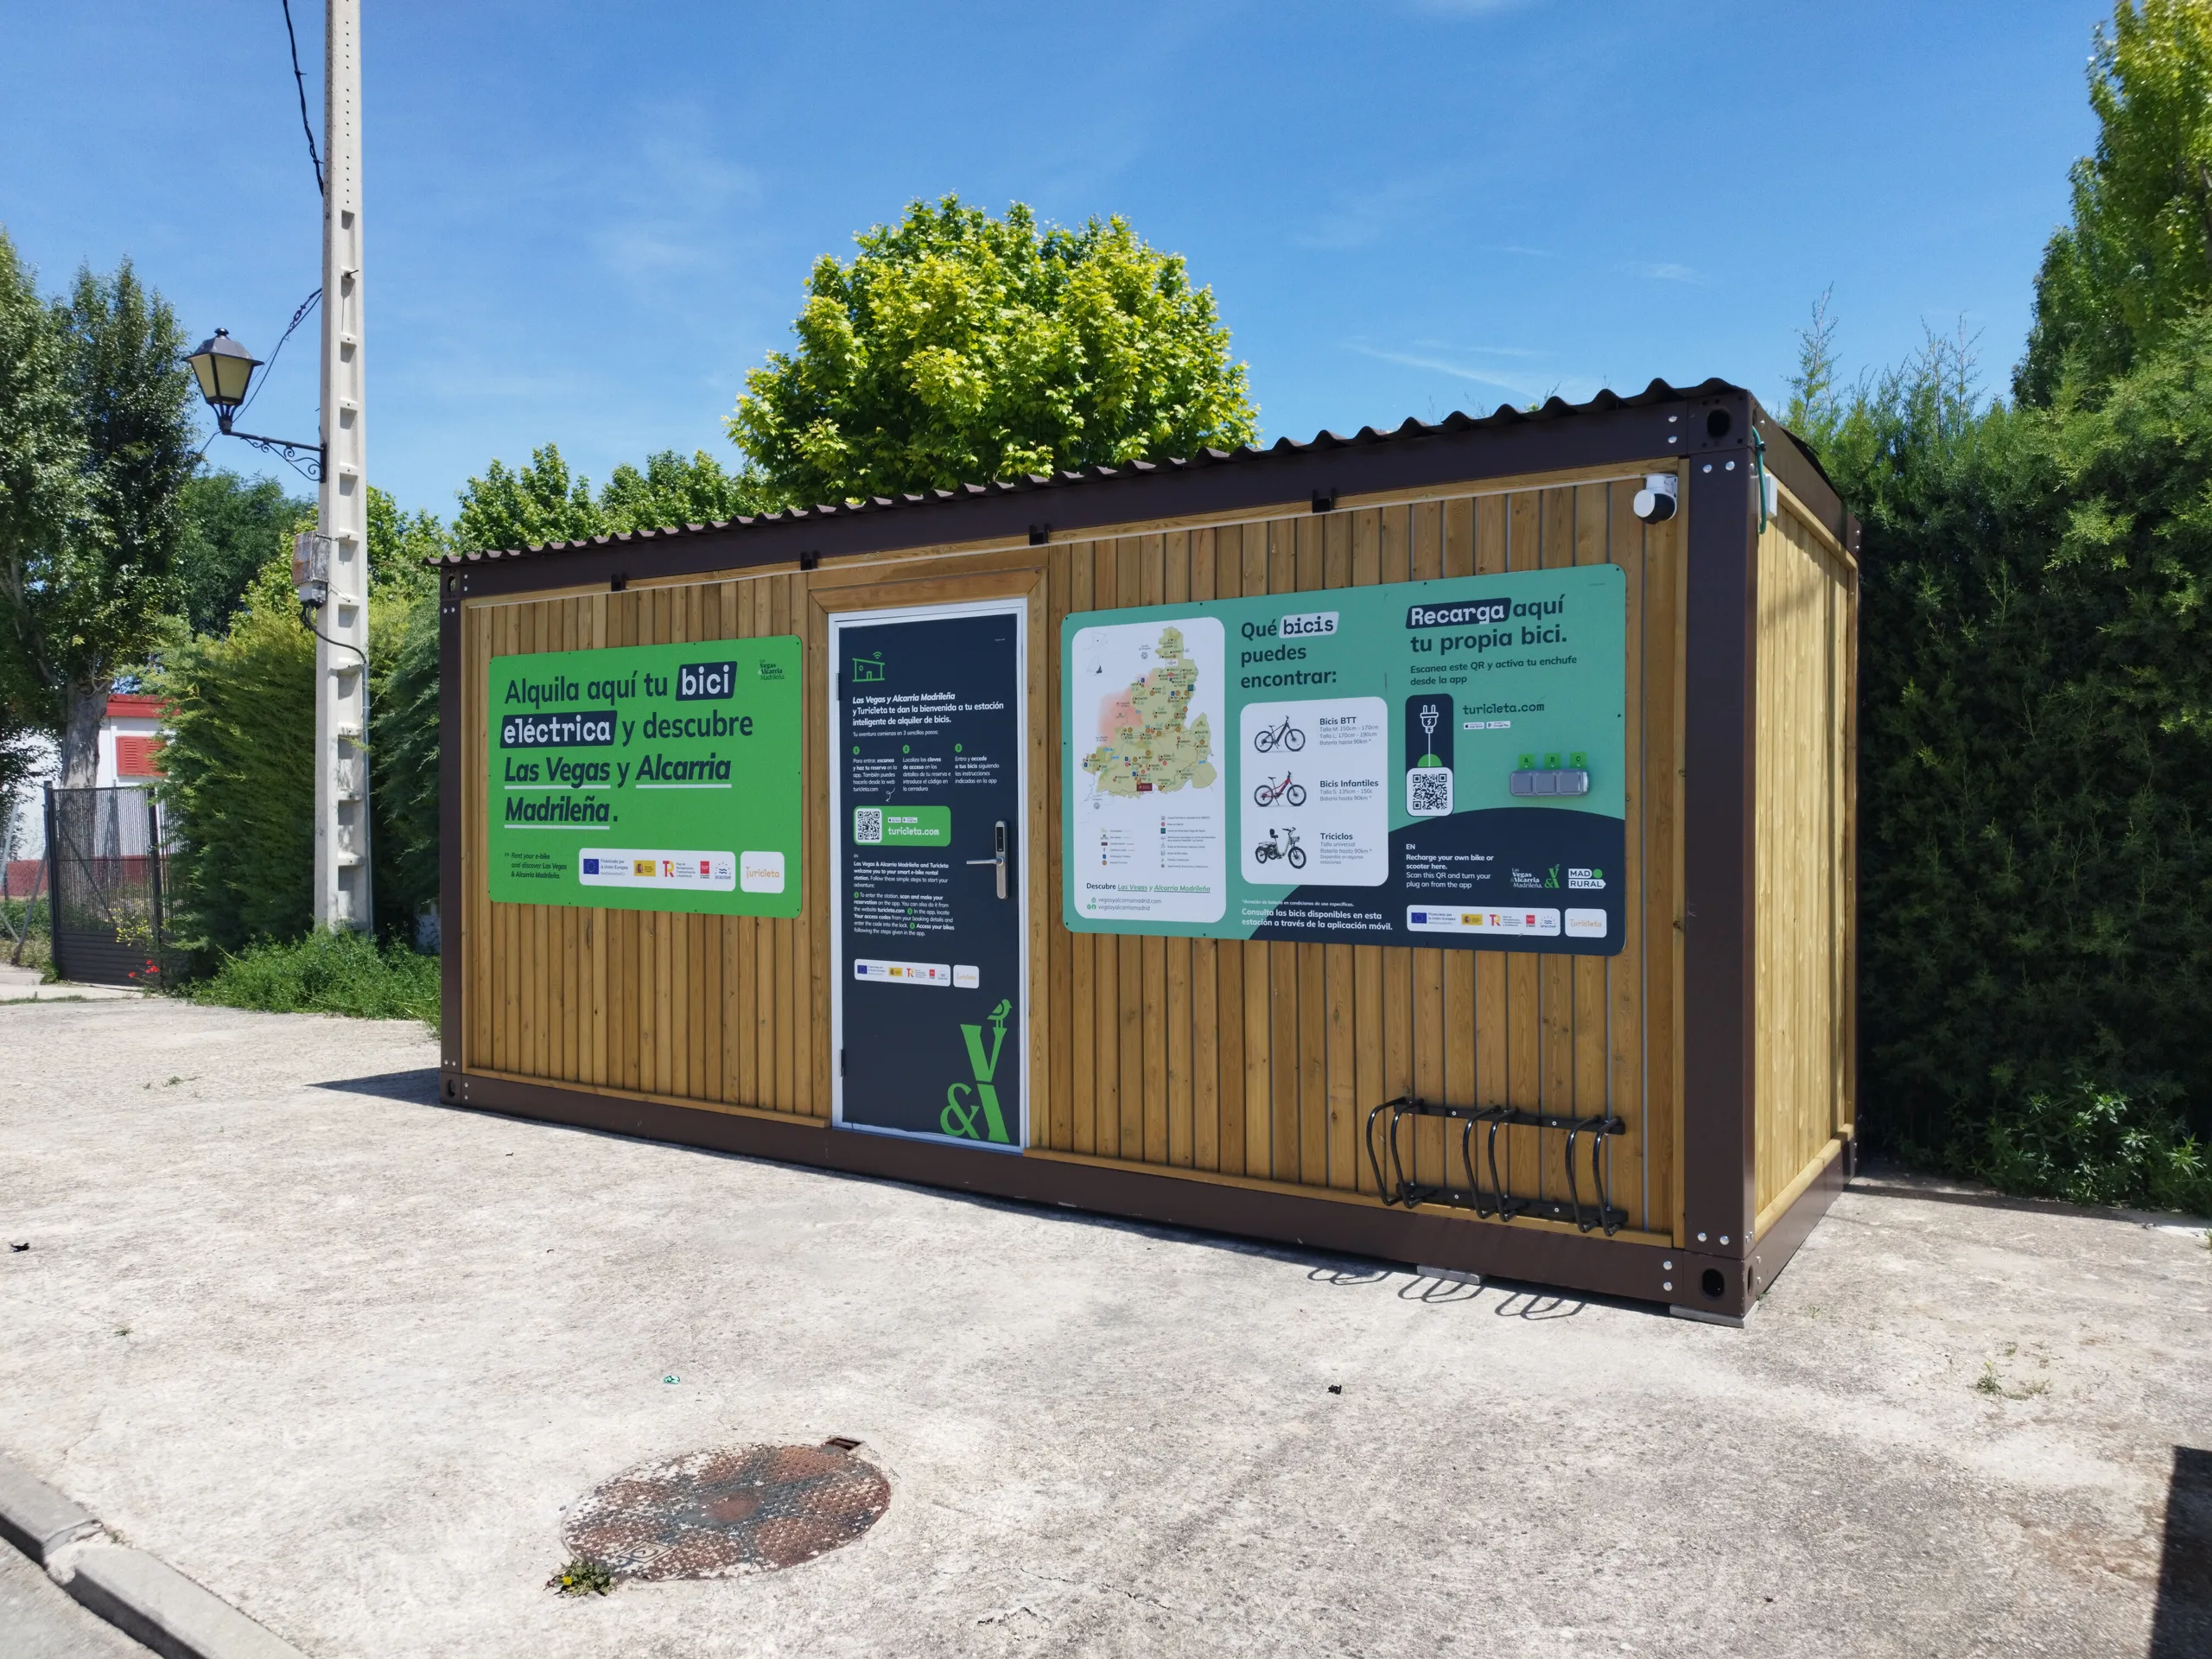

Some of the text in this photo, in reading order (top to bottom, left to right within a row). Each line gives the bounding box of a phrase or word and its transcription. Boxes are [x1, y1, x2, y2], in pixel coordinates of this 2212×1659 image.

[1411, 594, 1566, 626] Recarga aquí
[1242, 616, 1333, 641] Qué bicis
[1411, 624, 1567, 655] tu propia bici.
[1241, 645, 1306, 667] puedes
[1411, 664, 1446, 674] Escanea
[1449, 663, 1468, 671] este
[1471, 661, 1484, 671] QR
[1487, 662, 1493, 671] y
[1496, 658, 1524, 669] activa
[1539, 655, 1577, 666] enchufe
[505, 664, 729, 709] Alquila aquí tu bici
[1241, 671, 1337, 688] encontrar:
[1411, 676, 1467, 685] desde la app
[866, 696, 886, 704] Vegas
[921, 692, 955, 701] Madrileña
[920, 703, 956, 712] bienvenida
[975, 701, 1004, 710] estación
[1463, 702, 1544, 715] turicleta.com
[504, 709, 753, 746] eléctrica y descubre
[853, 718, 886, 728] inteligente
[898, 716, 922, 726] alquiler
[505, 753, 732, 789] Las Vegas y Alcarria
[888, 827, 939, 836] turicleta.com
[1307, 910, 1351, 918] disponibles
[1327, 921, 1367, 930] aplicación
[1369, 922, 1393, 931] móvil.
